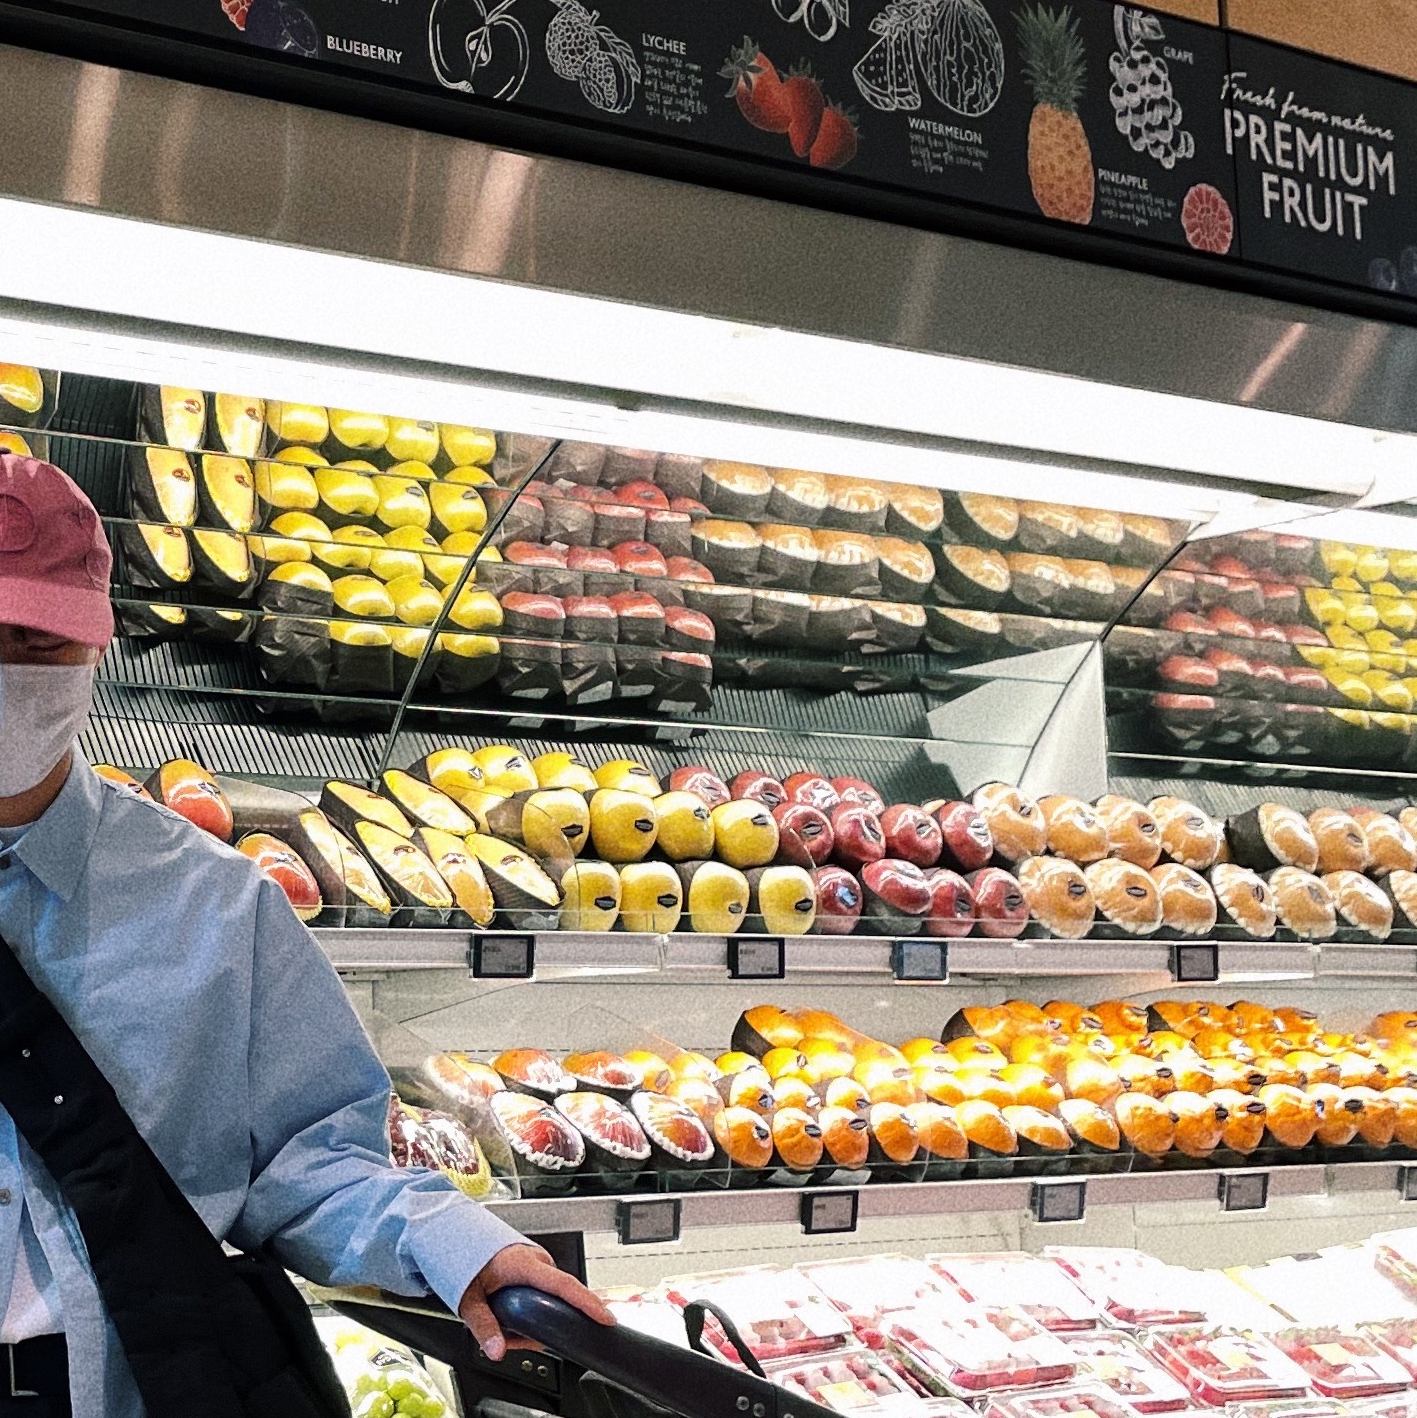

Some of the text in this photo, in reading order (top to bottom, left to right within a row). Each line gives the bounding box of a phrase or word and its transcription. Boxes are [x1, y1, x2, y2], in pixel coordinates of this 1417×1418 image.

[327, 35, 402, 64] BLUEBERRY
[642, 32, 686, 55] LYCHEE
[1220, 72, 1394, 141] Fresh from nature
[908, 116, 982, 144] WATERMELON
[1224, 108, 1395, 195] PREMIUM
[1098, 168, 1148, 191] PINEAPPLE
[1262, 172, 1368, 240] FRUIT
